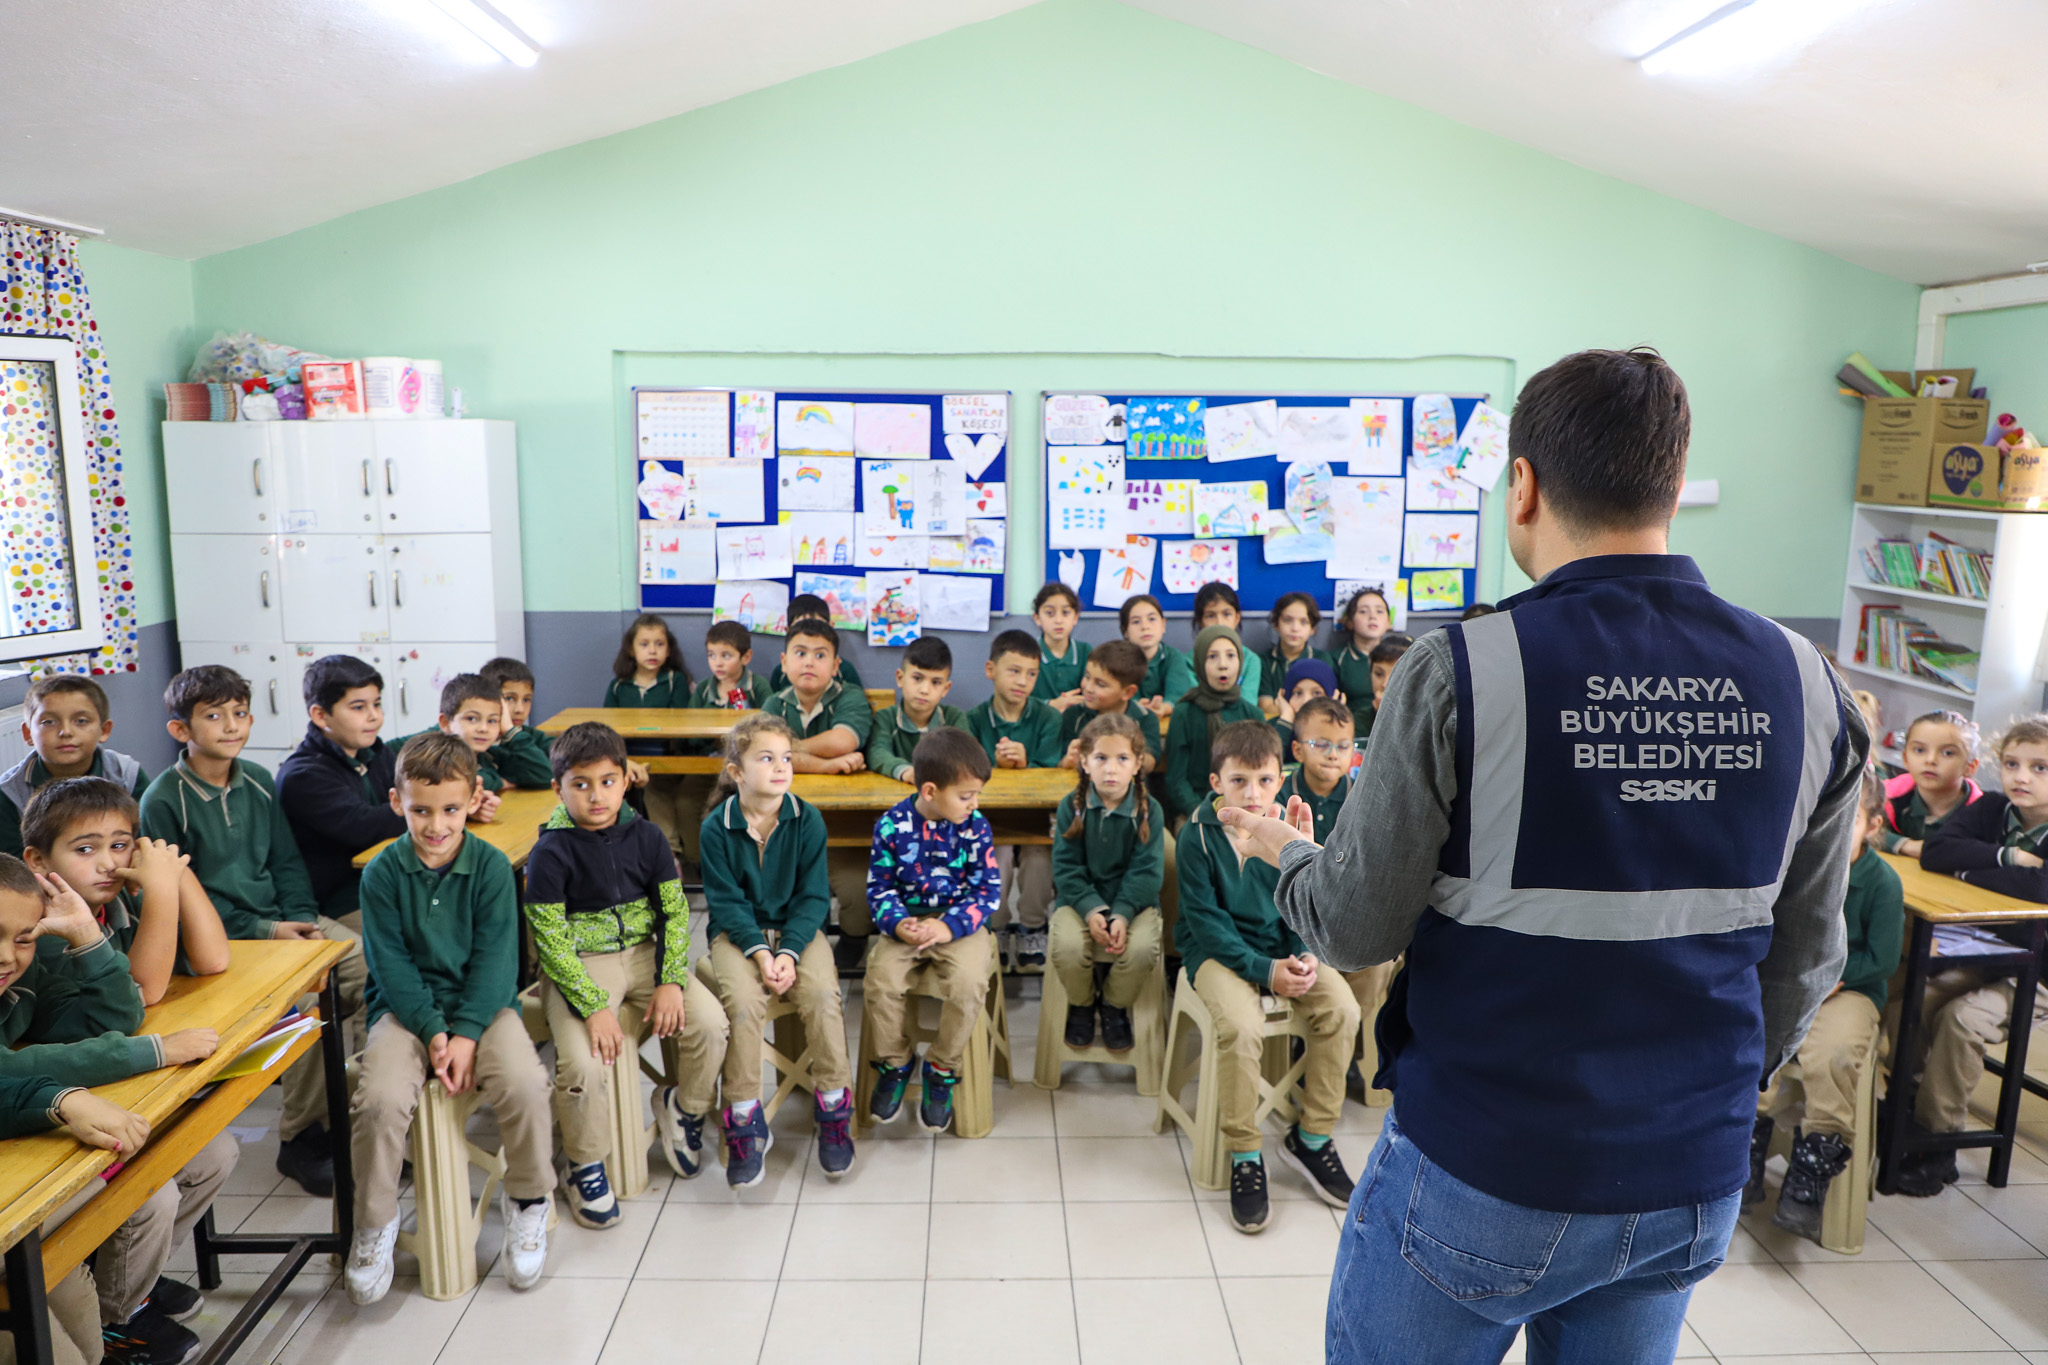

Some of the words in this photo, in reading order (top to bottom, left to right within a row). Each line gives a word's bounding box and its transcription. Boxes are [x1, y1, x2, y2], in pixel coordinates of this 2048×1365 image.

[1586, 675, 1744, 702] SAKARYA
[1560, 705, 1772, 739] BÜYÜKŞEHİR
[1574, 740, 1762, 770] BELEDİYESİ
